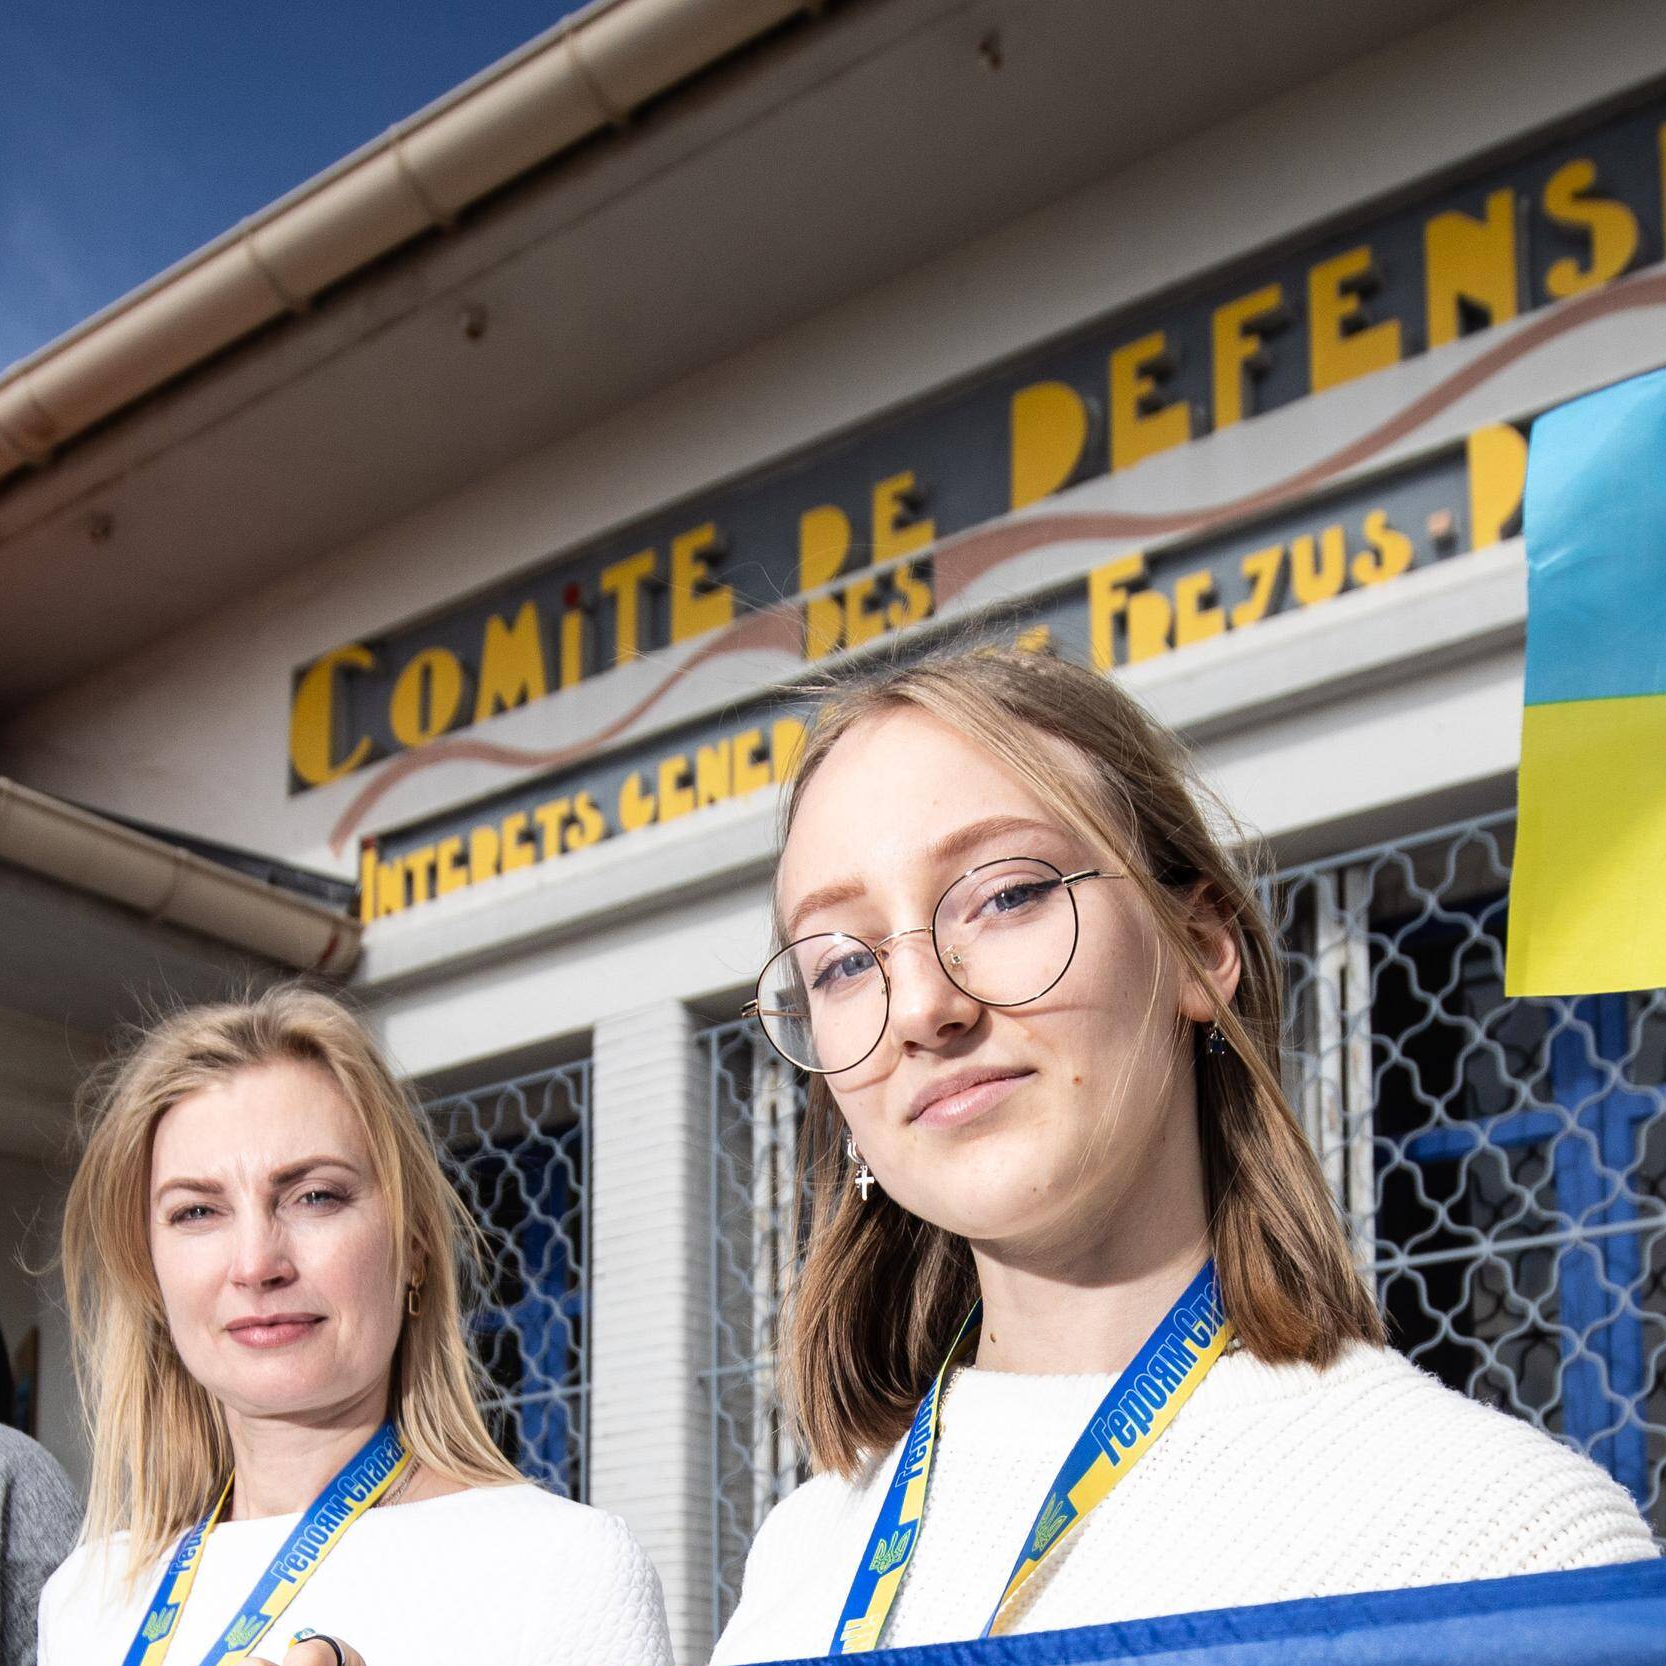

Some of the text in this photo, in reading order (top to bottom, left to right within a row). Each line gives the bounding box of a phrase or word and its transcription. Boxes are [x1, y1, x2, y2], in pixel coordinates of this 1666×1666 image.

[799, 472, 935, 592] DE
[804, 563, 933, 661] DES
[359, 797, 606, 925] INTERETS
[1090, 1332, 1198, 1468] Героям
[269, 1499, 354, 1584] Героям
